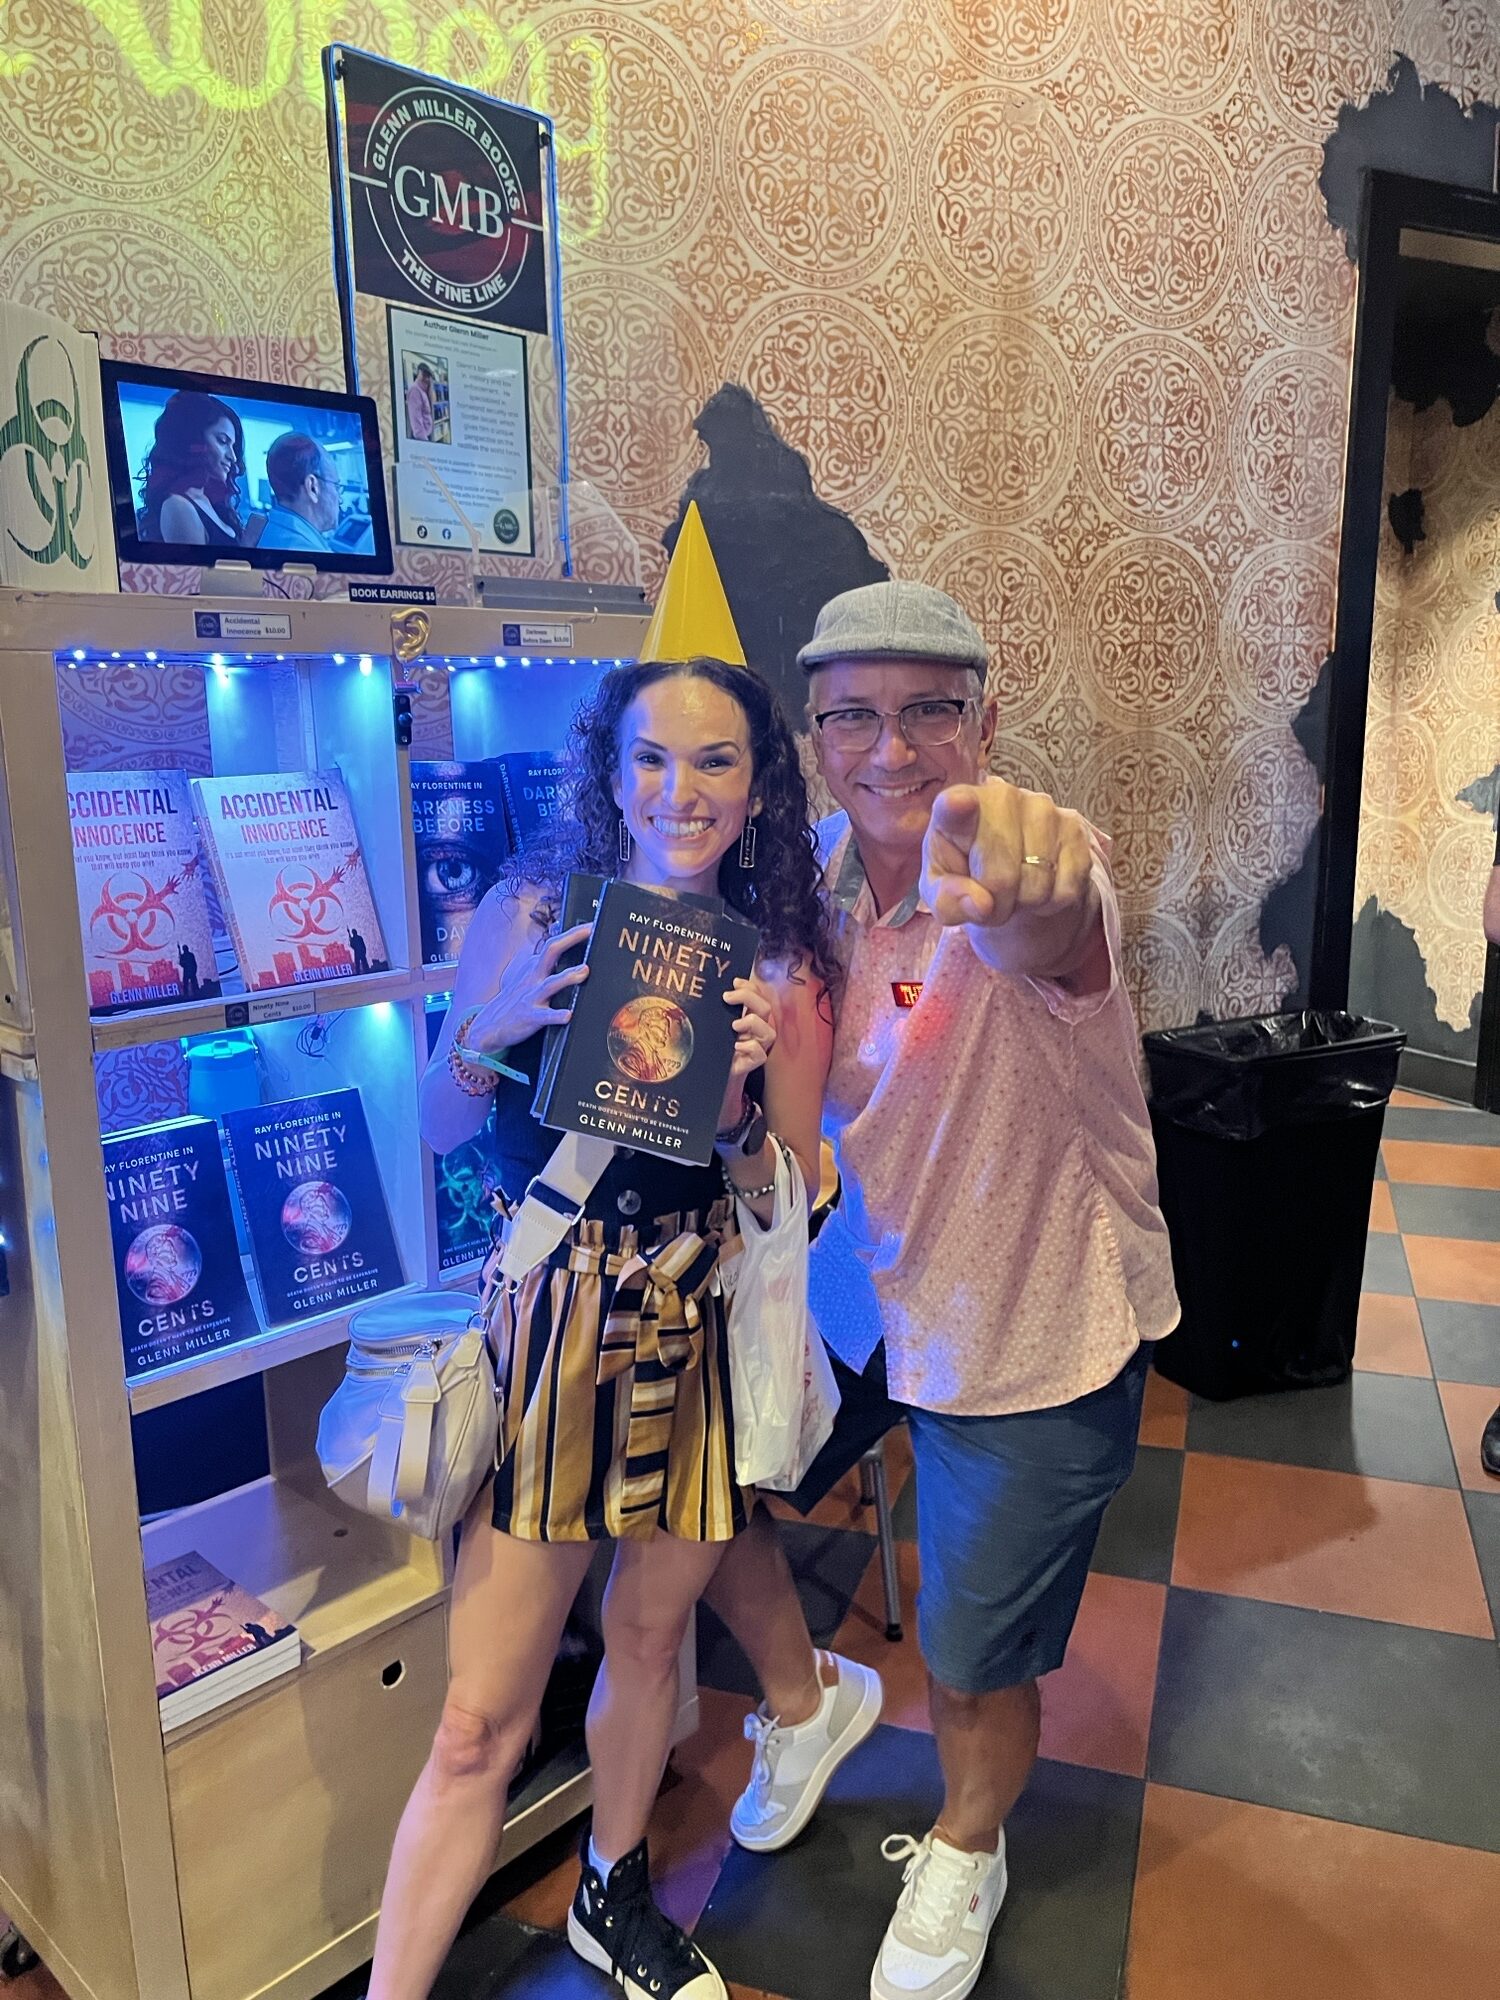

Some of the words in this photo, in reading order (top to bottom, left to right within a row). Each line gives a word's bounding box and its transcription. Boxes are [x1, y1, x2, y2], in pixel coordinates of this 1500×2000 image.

[372, 105, 412, 171] GLENN
[413, 98, 478, 136] MILLER
[479, 130, 521, 211] BOOKS
[394, 165, 504, 239] GMB
[401, 248, 433, 289] THE
[435, 280, 472, 304] FINE
[473, 273, 507, 303] LINE
[424, 320, 448, 332] Author
[449, 327, 469, 336] Glenn
[470, 330, 489, 341] Miller
[351, 588, 378, 598] BOOK
[380, 589, 424, 600] EARRINGS
[425, 591, 435, 600] $5
[224, 616, 261, 625] Accidental
[226, 628, 261, 636] Innocence
[409, 782, 420, 790] AY
[422, 781, 472, 790] FLORENTINE
[473, 781, 483, 790] IN
[528, 769, 541, 777] RAY
[66, 788, 178, 819] CCIDENTAL
[220, 788, 339, 819] ACCIDENTAL
[411, 799, 495, 815] ARKNESS
[73, 822, 167, 848] NNOCENCE
[241, 818, 330, 844] INNOCENCE
[412, 817, 486, 833] BEFORE
[629, 912, 651, 925] RAY
[652, 918, 718, 948] FLORENTINE
[719, 940, 732, 952] IN
[618, 927, 732, 979] NINETY
[293, 968, 322, 983] GLENN
[321, 963, 353, 979] MILLER
[631, 958, 707, 999] NINE
[110, 987, 143, 1005] GLENN
[143, 982, 180, 999] MILLER
[252, 1003, 274, 1012] Ninety
[263, 1011, 282, 1019] Cents
[594, 1080, 681, 1118] CENTS
[254, 1125, 272, 1134] RAY
[274, 1113, 330, 1131] FLORENTINE
[331, 1111, 342, 1119] IN
[577, 1100, 597, 1110] DEATH
[640, 1116, 649, 1124] TO
[649, 1119, 658, 1127] BE
[658, 1122, 690, 1135] EXPENSIVE
[579, 1114, 627, 1135] GLENN
[631, 1127, 683, 1149] MILLER
[224, 1128, 237, 1167] NINETY
[254, 1124, 347, 1161] NINETY
[103, 1163, 116, 1174] AY
[119, 1149, 181, 1171] FLORENTINE
[182, 1145, 194, 1156] IN
[276, 1150, 338, 1179] NINE
[120, 1188, 188, 1224] NINE
[293, 1251, 365, 1283] CENTS
[442, 1250, 475, 1267] GLENN
[293, 1291, 333, 1310] GLENN
[336, 1278, 378, 1298] MILLER
[138, 1300, 216, 1337] CENTS
[137, 1345, 181, 1367] GLENN
[184, 1328, 232, 1351] MILLER
